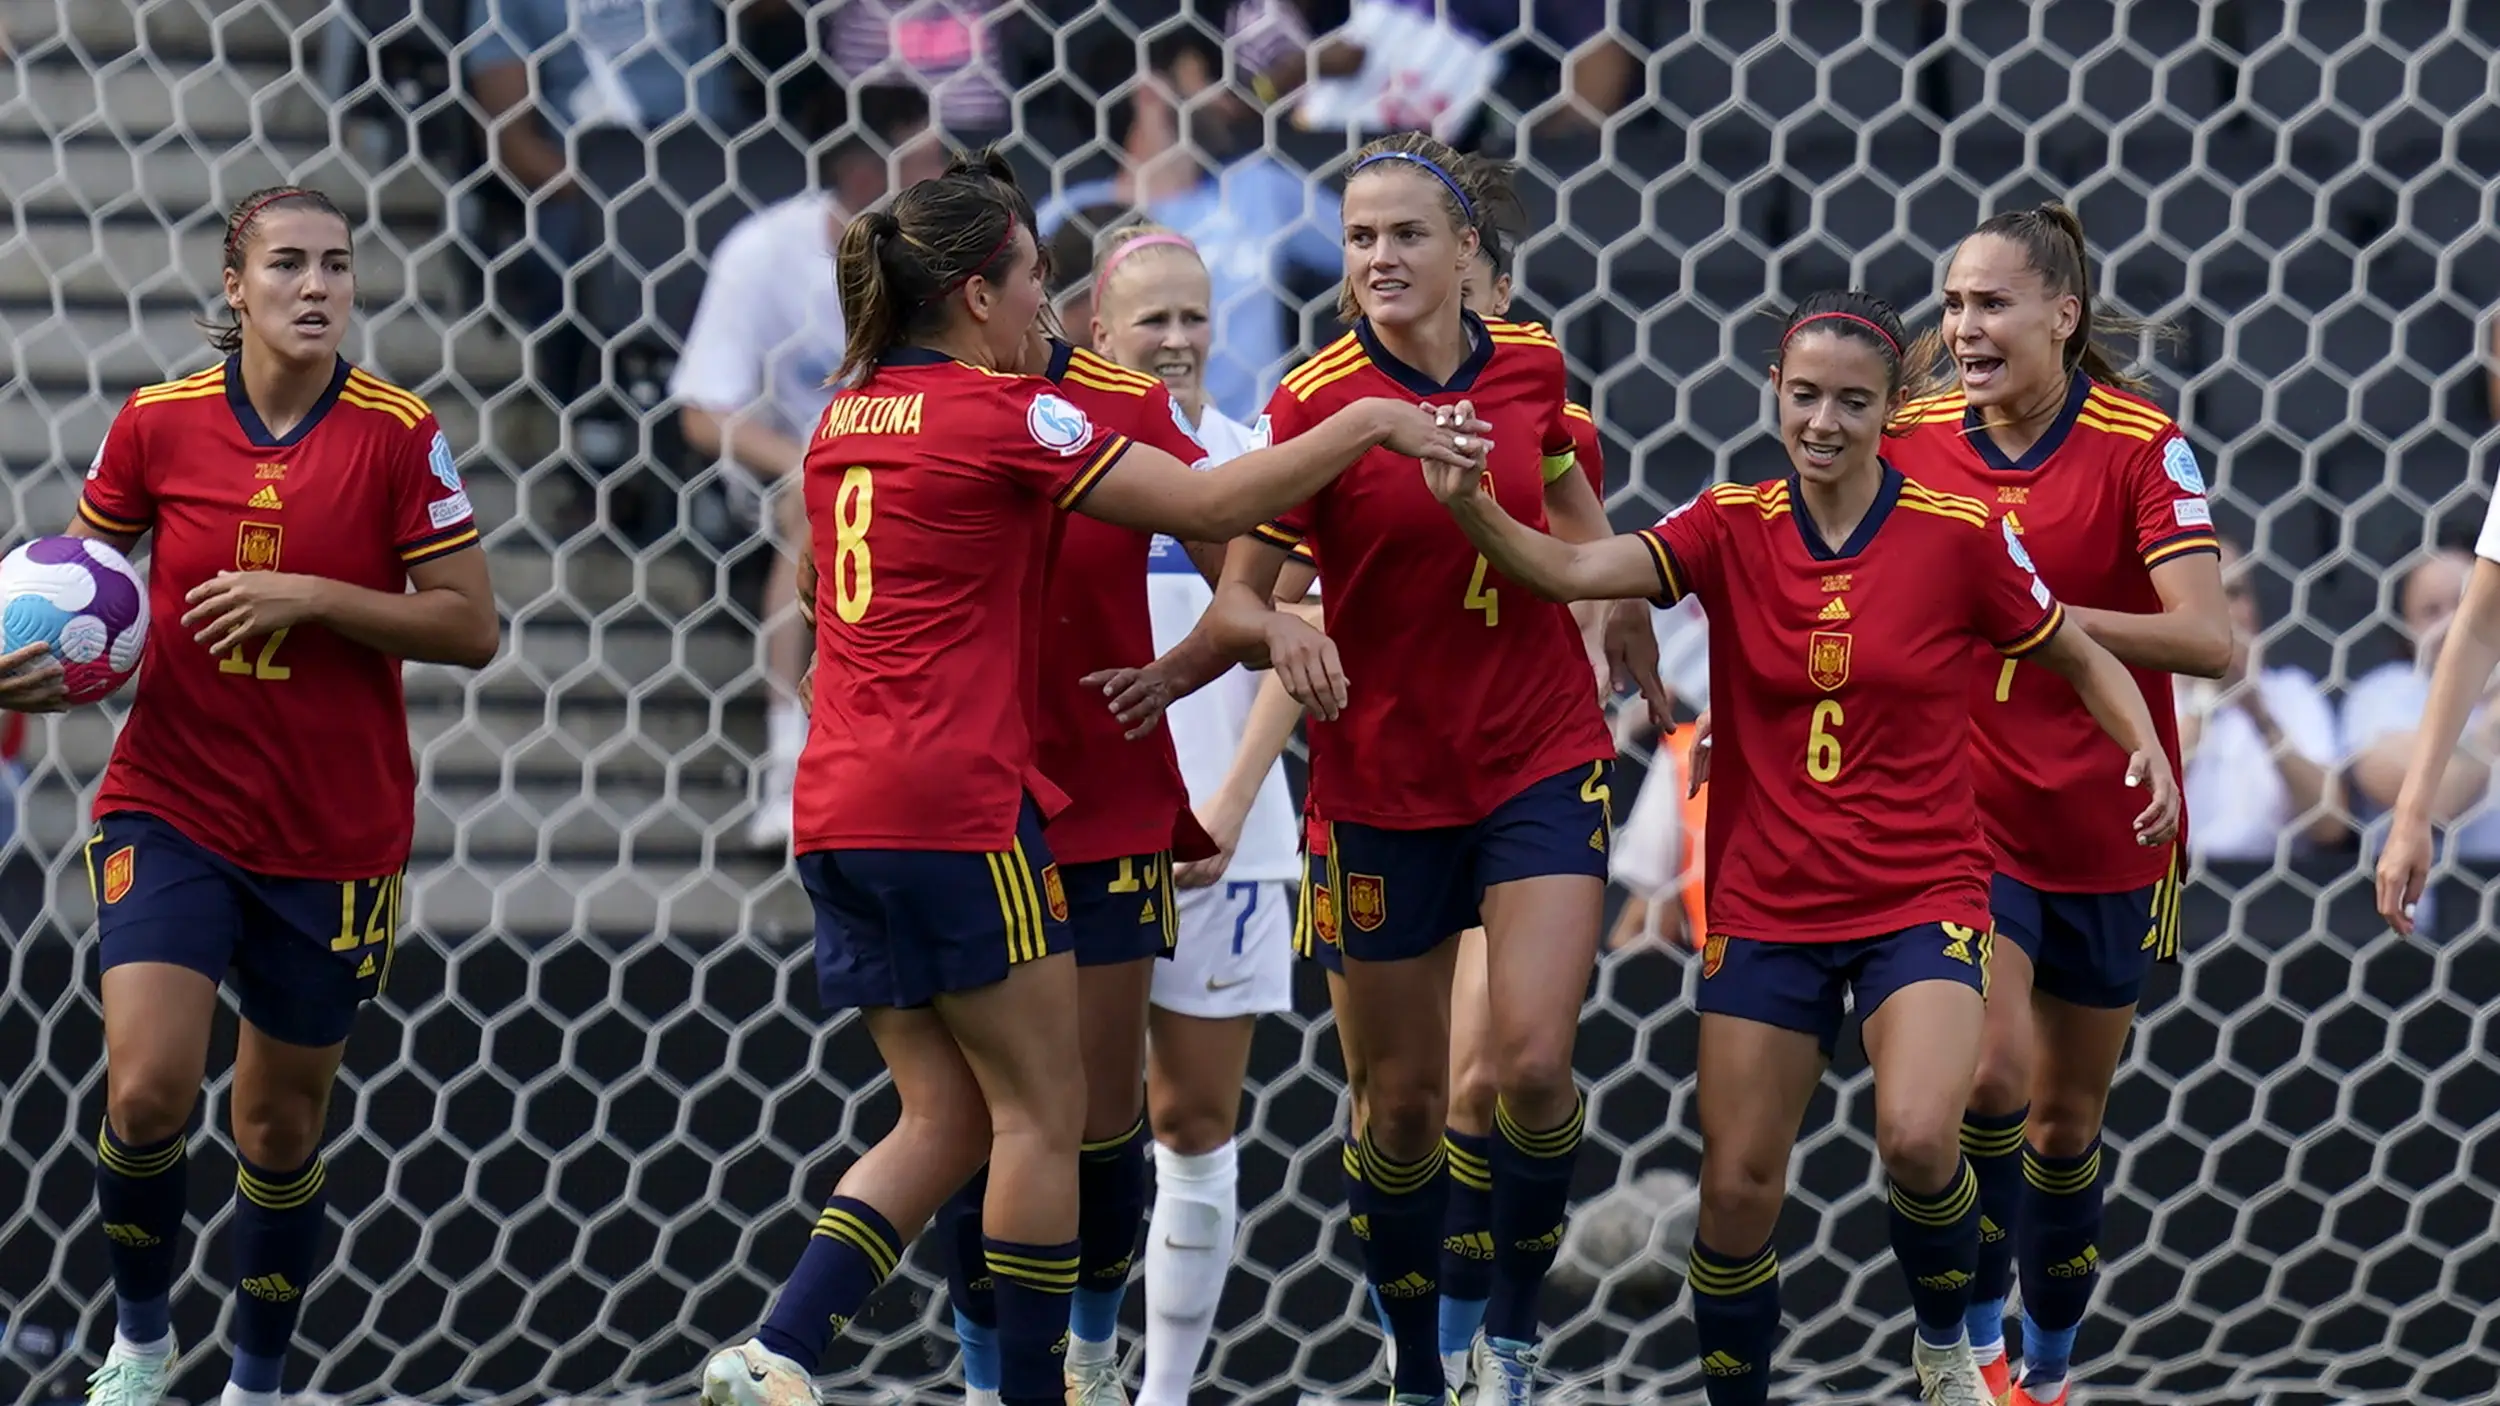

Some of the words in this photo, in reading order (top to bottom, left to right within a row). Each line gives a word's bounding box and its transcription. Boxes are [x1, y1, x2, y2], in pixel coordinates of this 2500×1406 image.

[821, 392, 925, 440] MARIONA
[834, 465, 873, 624] 8
[1463, 552, 1499, 628] 4
[1807, 699, 1845, 783] 6
[330, 876, 386, 952] 12
[1226, 881, 1258, 956] 7
